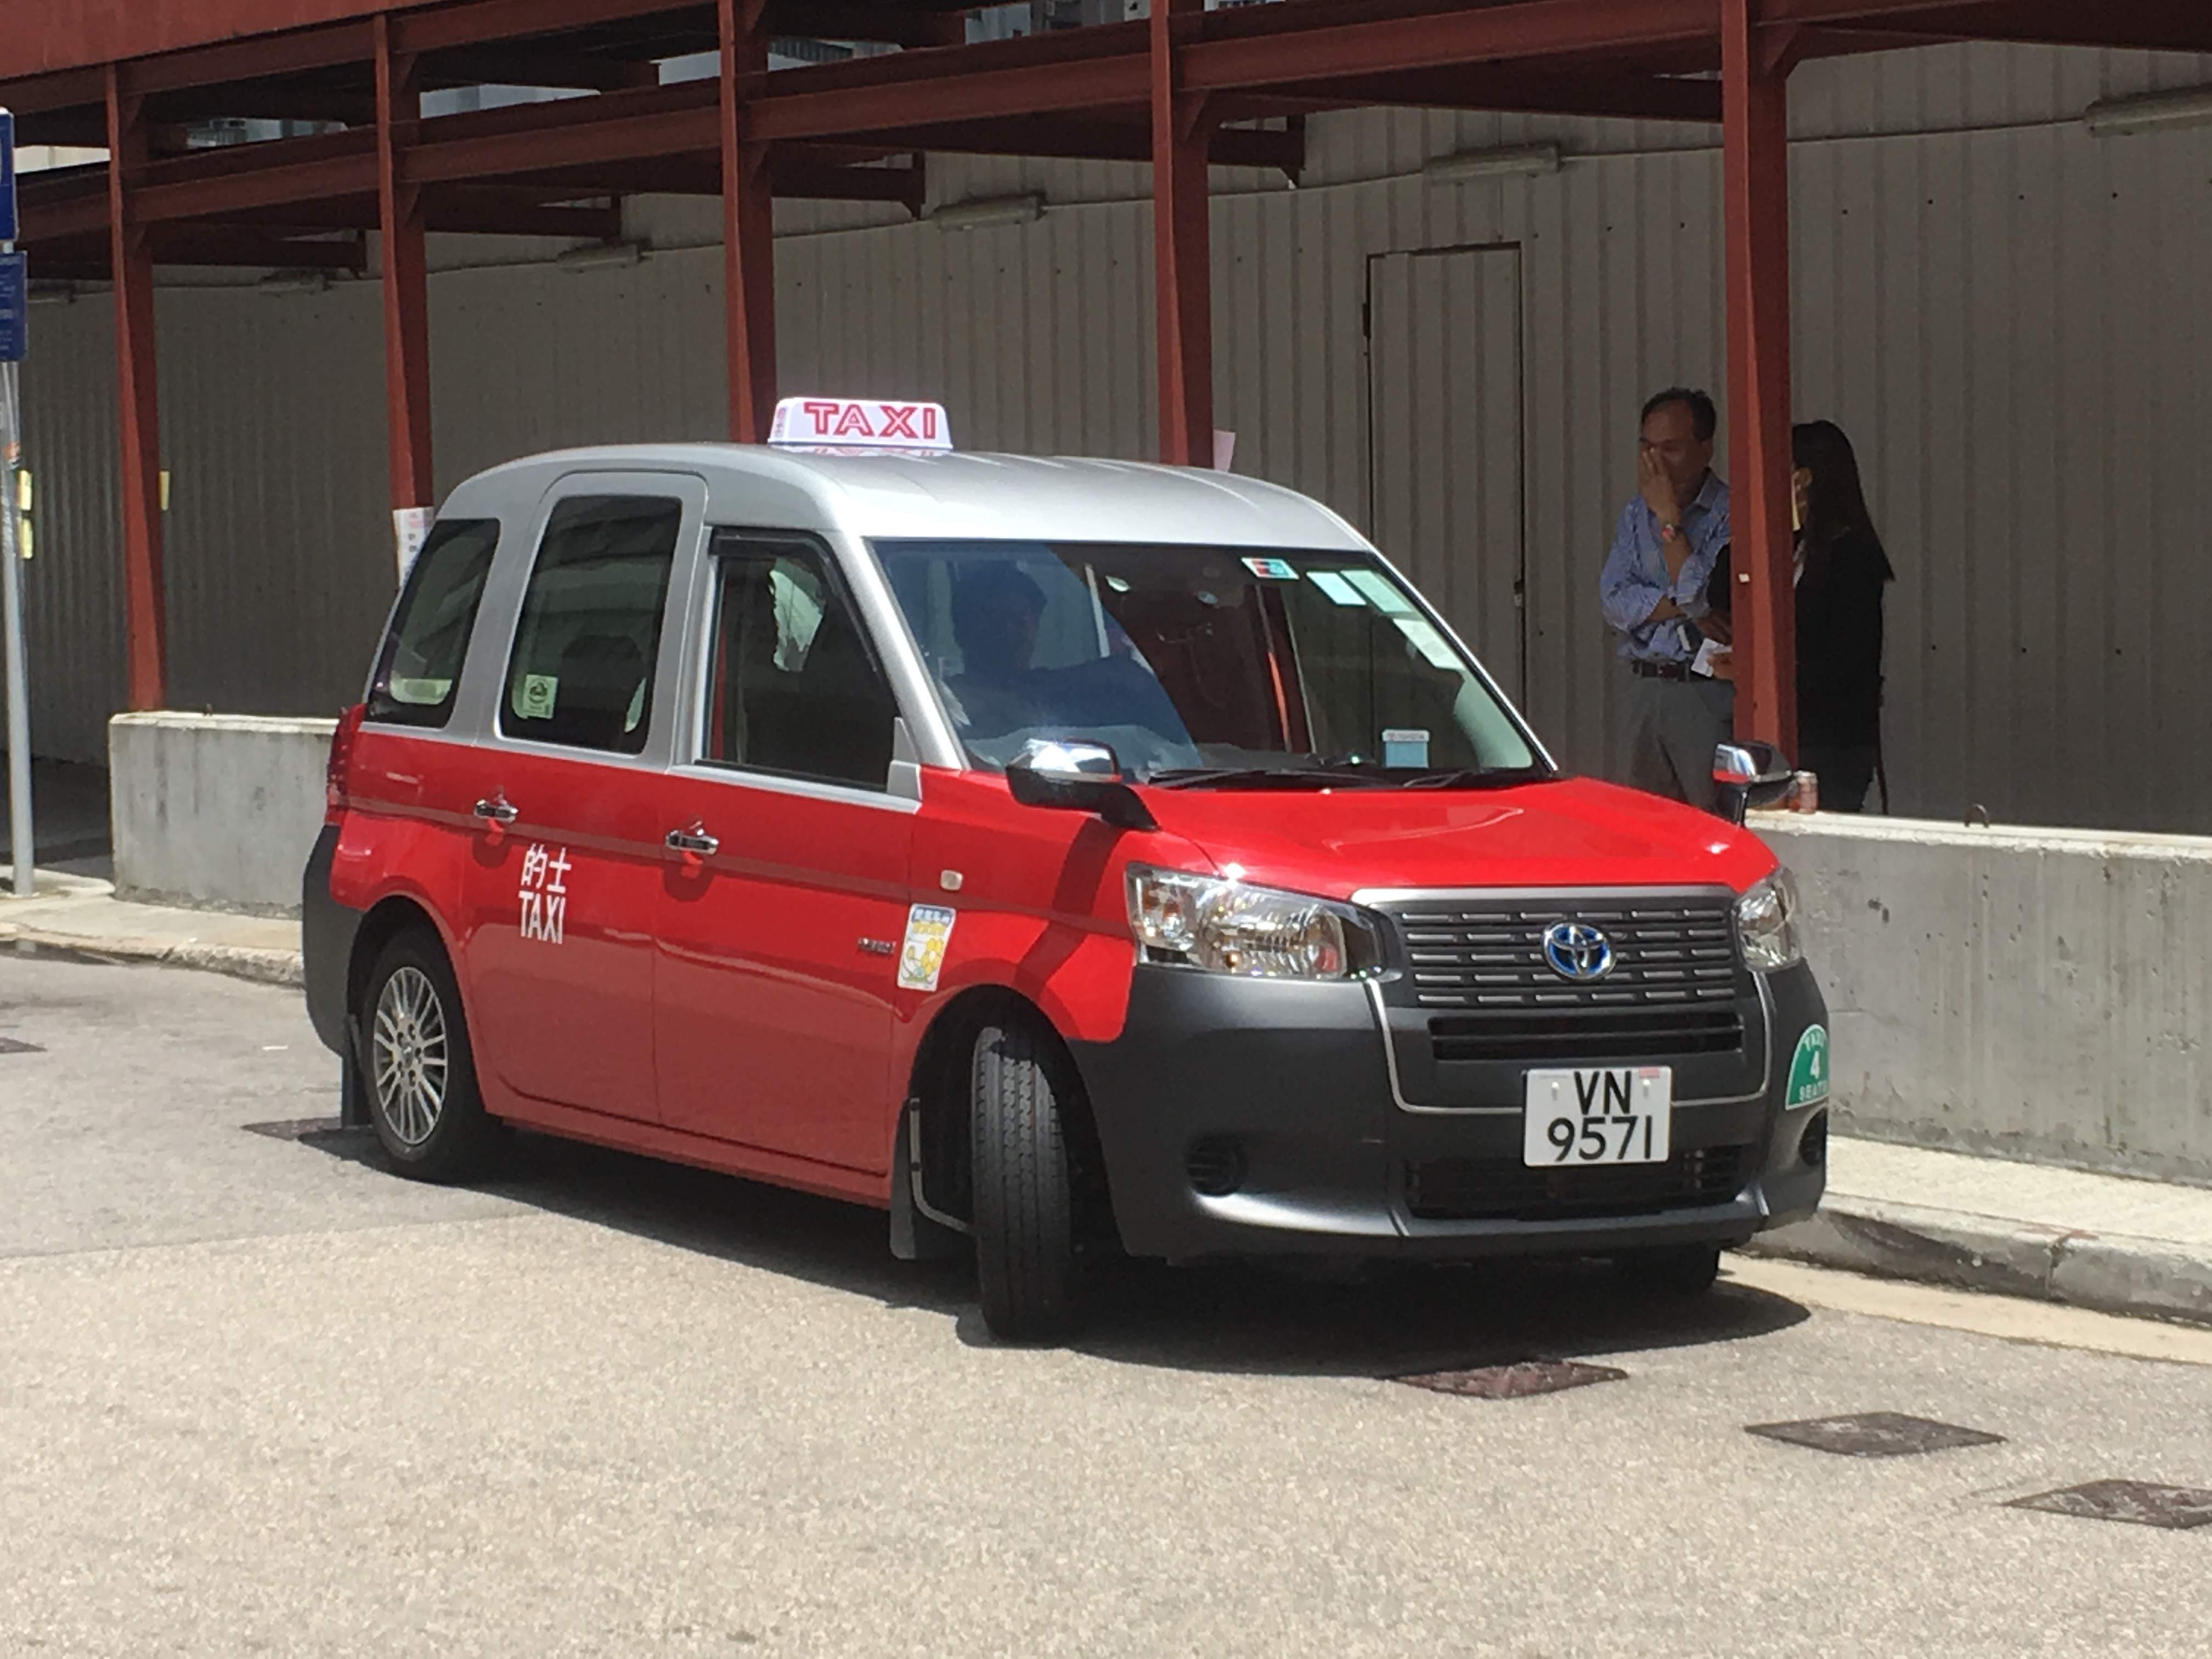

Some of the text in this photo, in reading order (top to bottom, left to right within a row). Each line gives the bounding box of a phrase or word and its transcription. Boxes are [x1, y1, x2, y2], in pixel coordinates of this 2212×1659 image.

[804, 402, 936, 439] TAXI
[521, 843, 571, 893] 的士
[518, 890, 566, 944] TAXI
[1810, 1051, 1820, 1079] 4
[1573, 1070, 1632, 1115] VN
[1547, 1115, 1652, 1162] 9571
